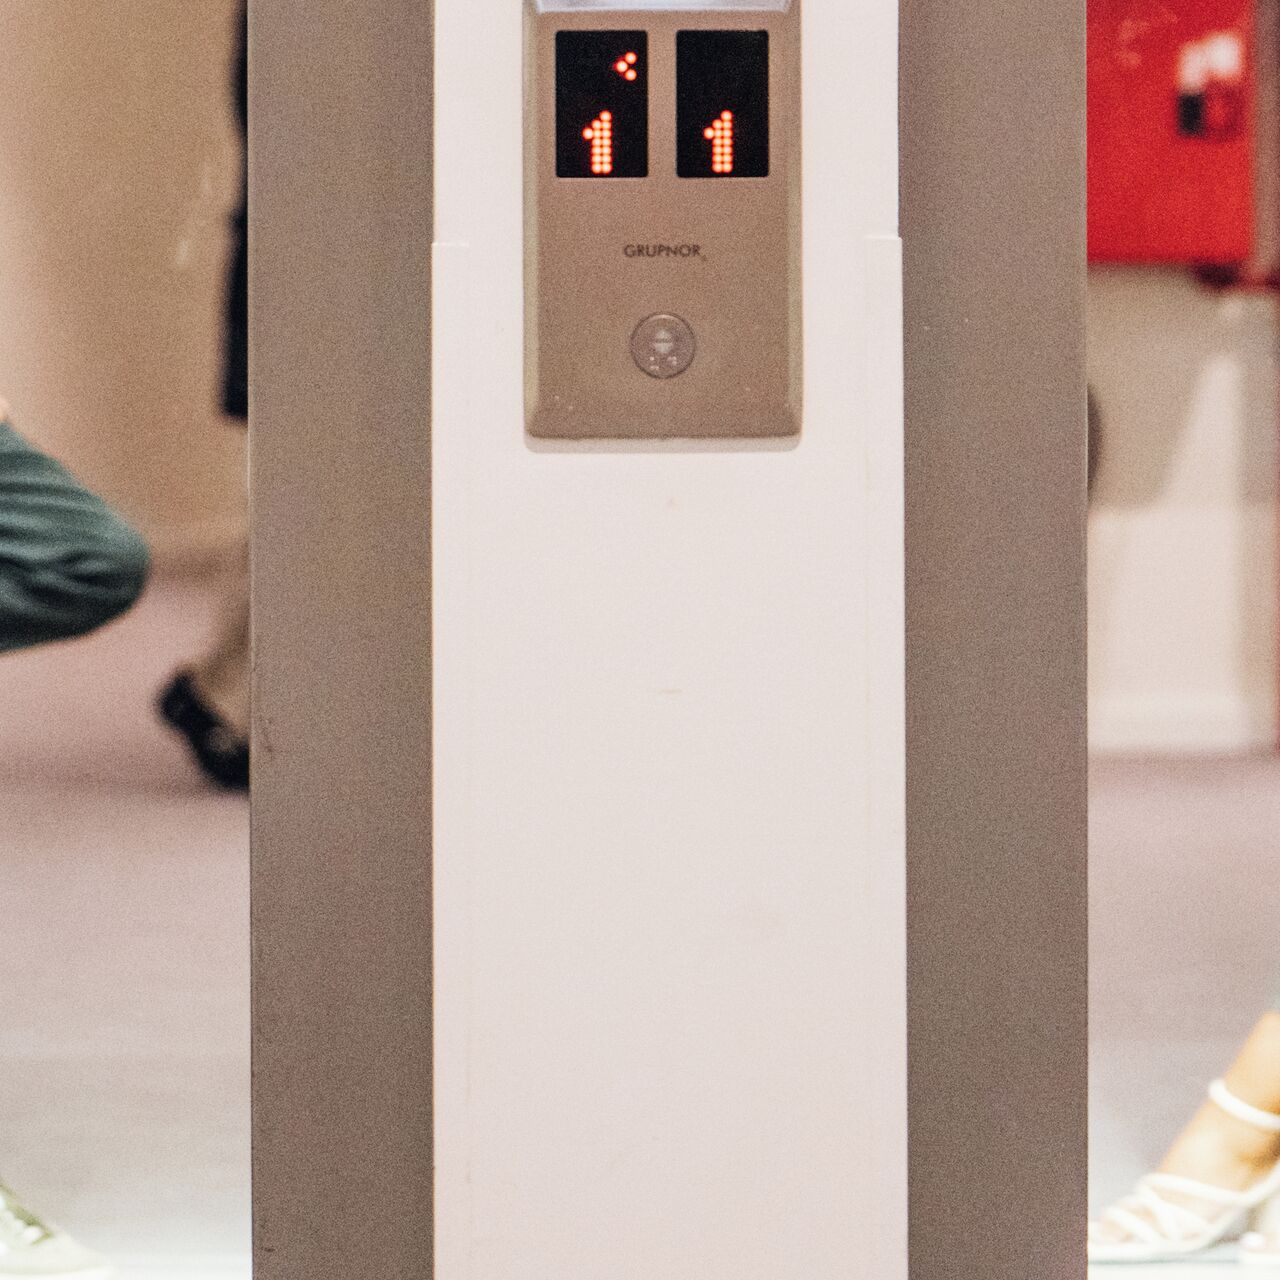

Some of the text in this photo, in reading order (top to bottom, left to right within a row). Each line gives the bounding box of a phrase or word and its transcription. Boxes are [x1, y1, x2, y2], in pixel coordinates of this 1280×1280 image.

[582, 110, 613, 174] 1
[703, 110, 733, 173] 1
[623, 243, 702, 259] GRUPNOR
